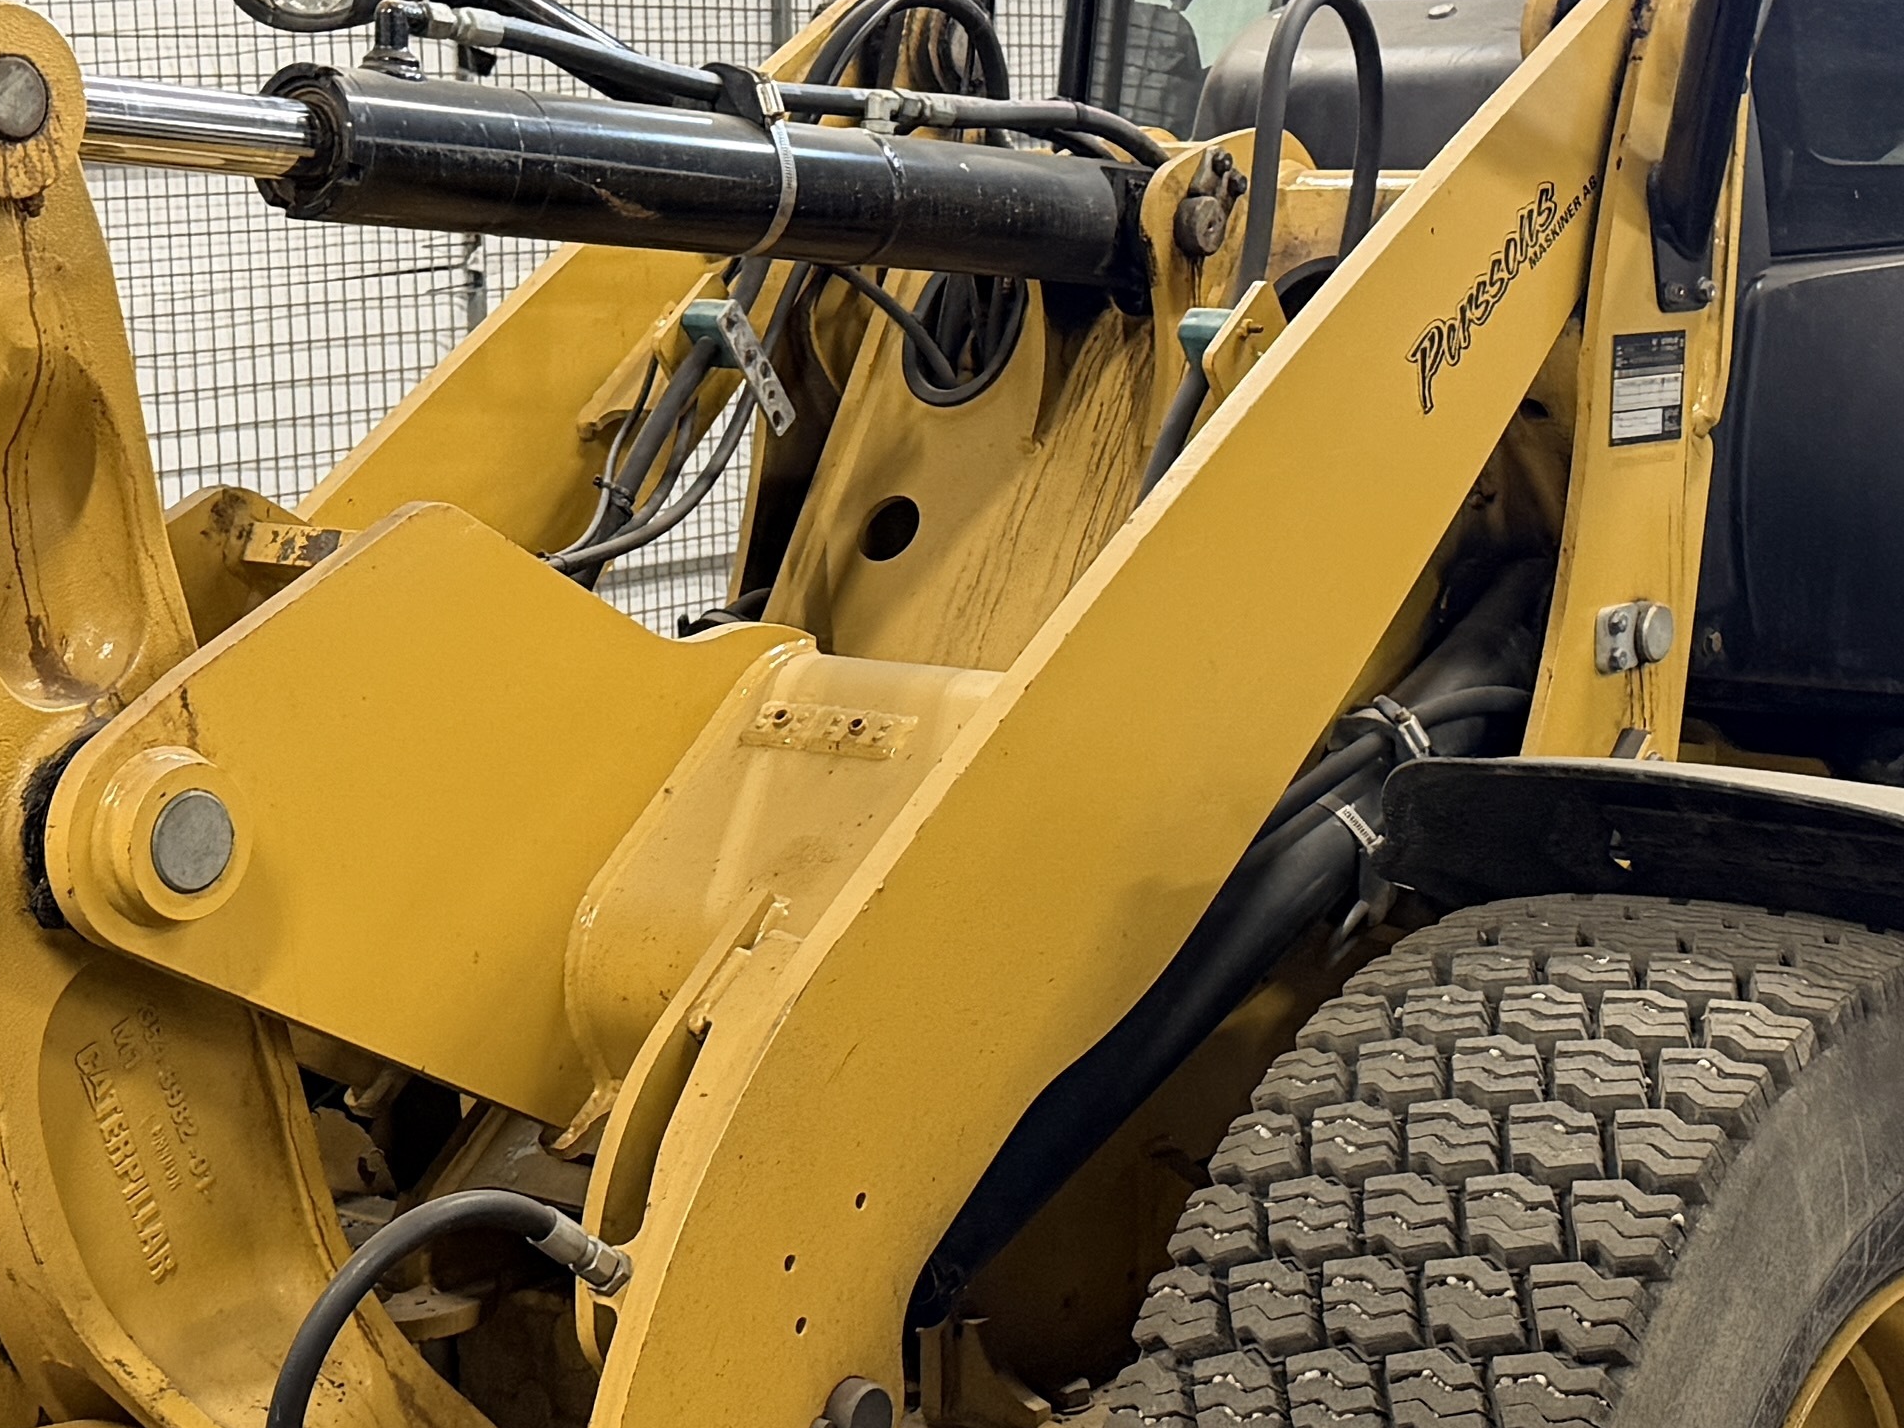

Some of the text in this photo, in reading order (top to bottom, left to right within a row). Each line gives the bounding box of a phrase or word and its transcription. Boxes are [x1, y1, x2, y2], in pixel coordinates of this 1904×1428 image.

[1405, 181, 1557, 414] Perssons
[1528, 195, 1583, 270] MASKINER
[75, 1040, 178, 1285] CATERPILLAR
